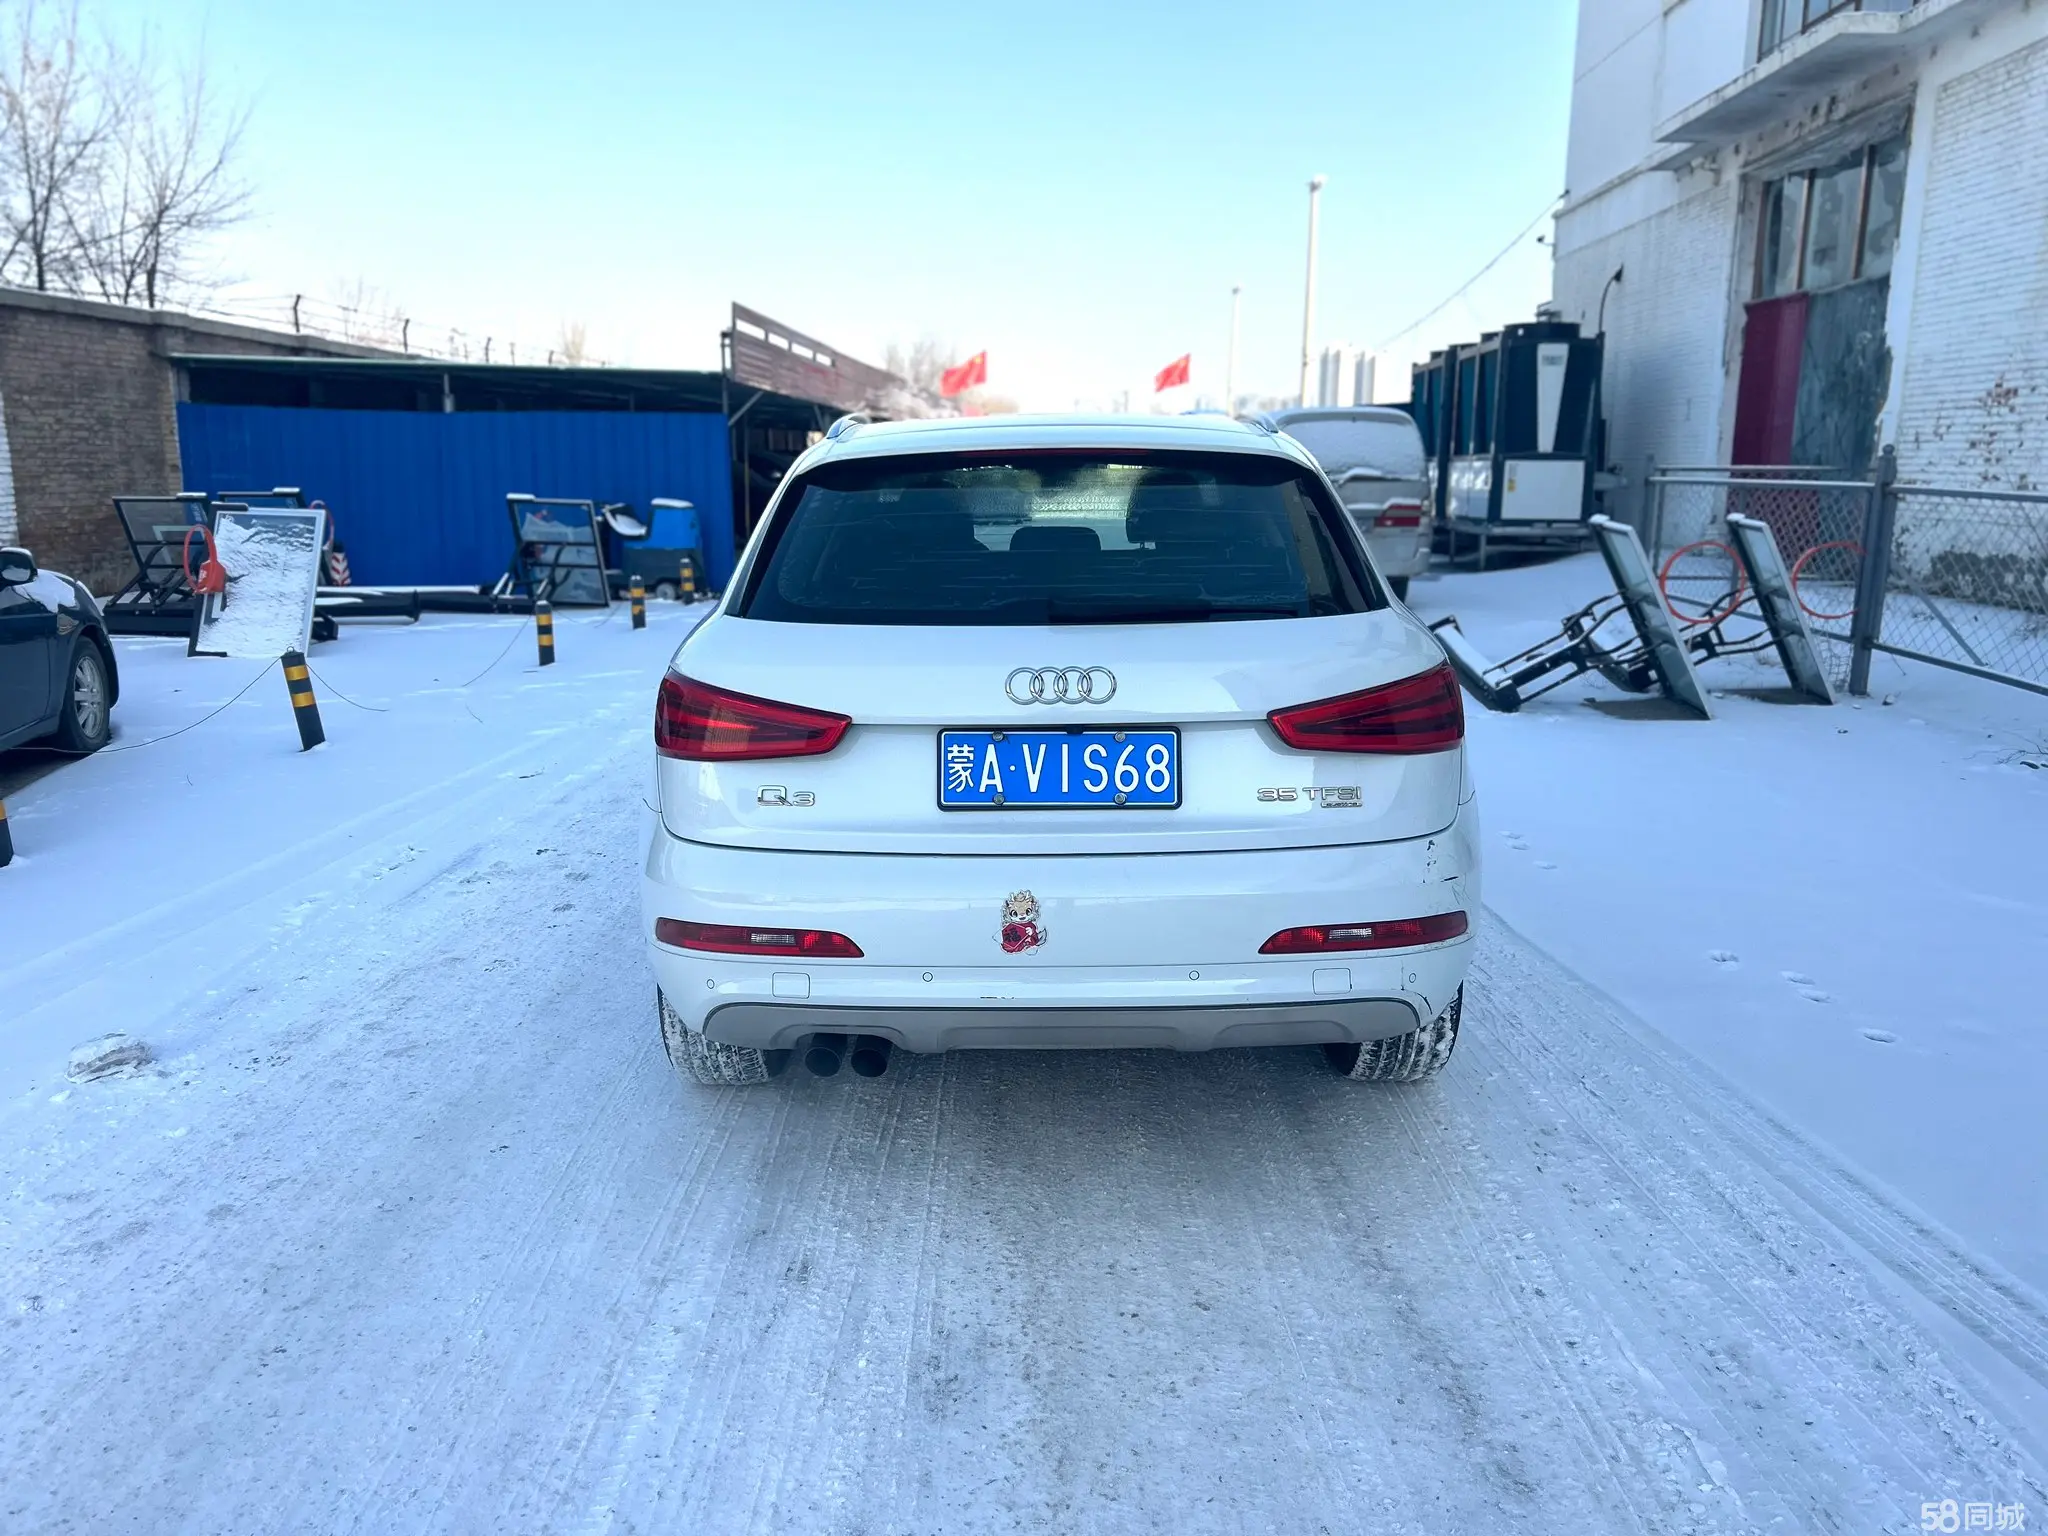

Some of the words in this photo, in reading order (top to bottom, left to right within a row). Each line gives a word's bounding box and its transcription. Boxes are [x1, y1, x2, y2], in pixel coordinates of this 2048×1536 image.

[757, 784, 816, 807] Q3
[1257, 787, 1298, 802] 35
[1302, 785, 1362, 801] TFSI
